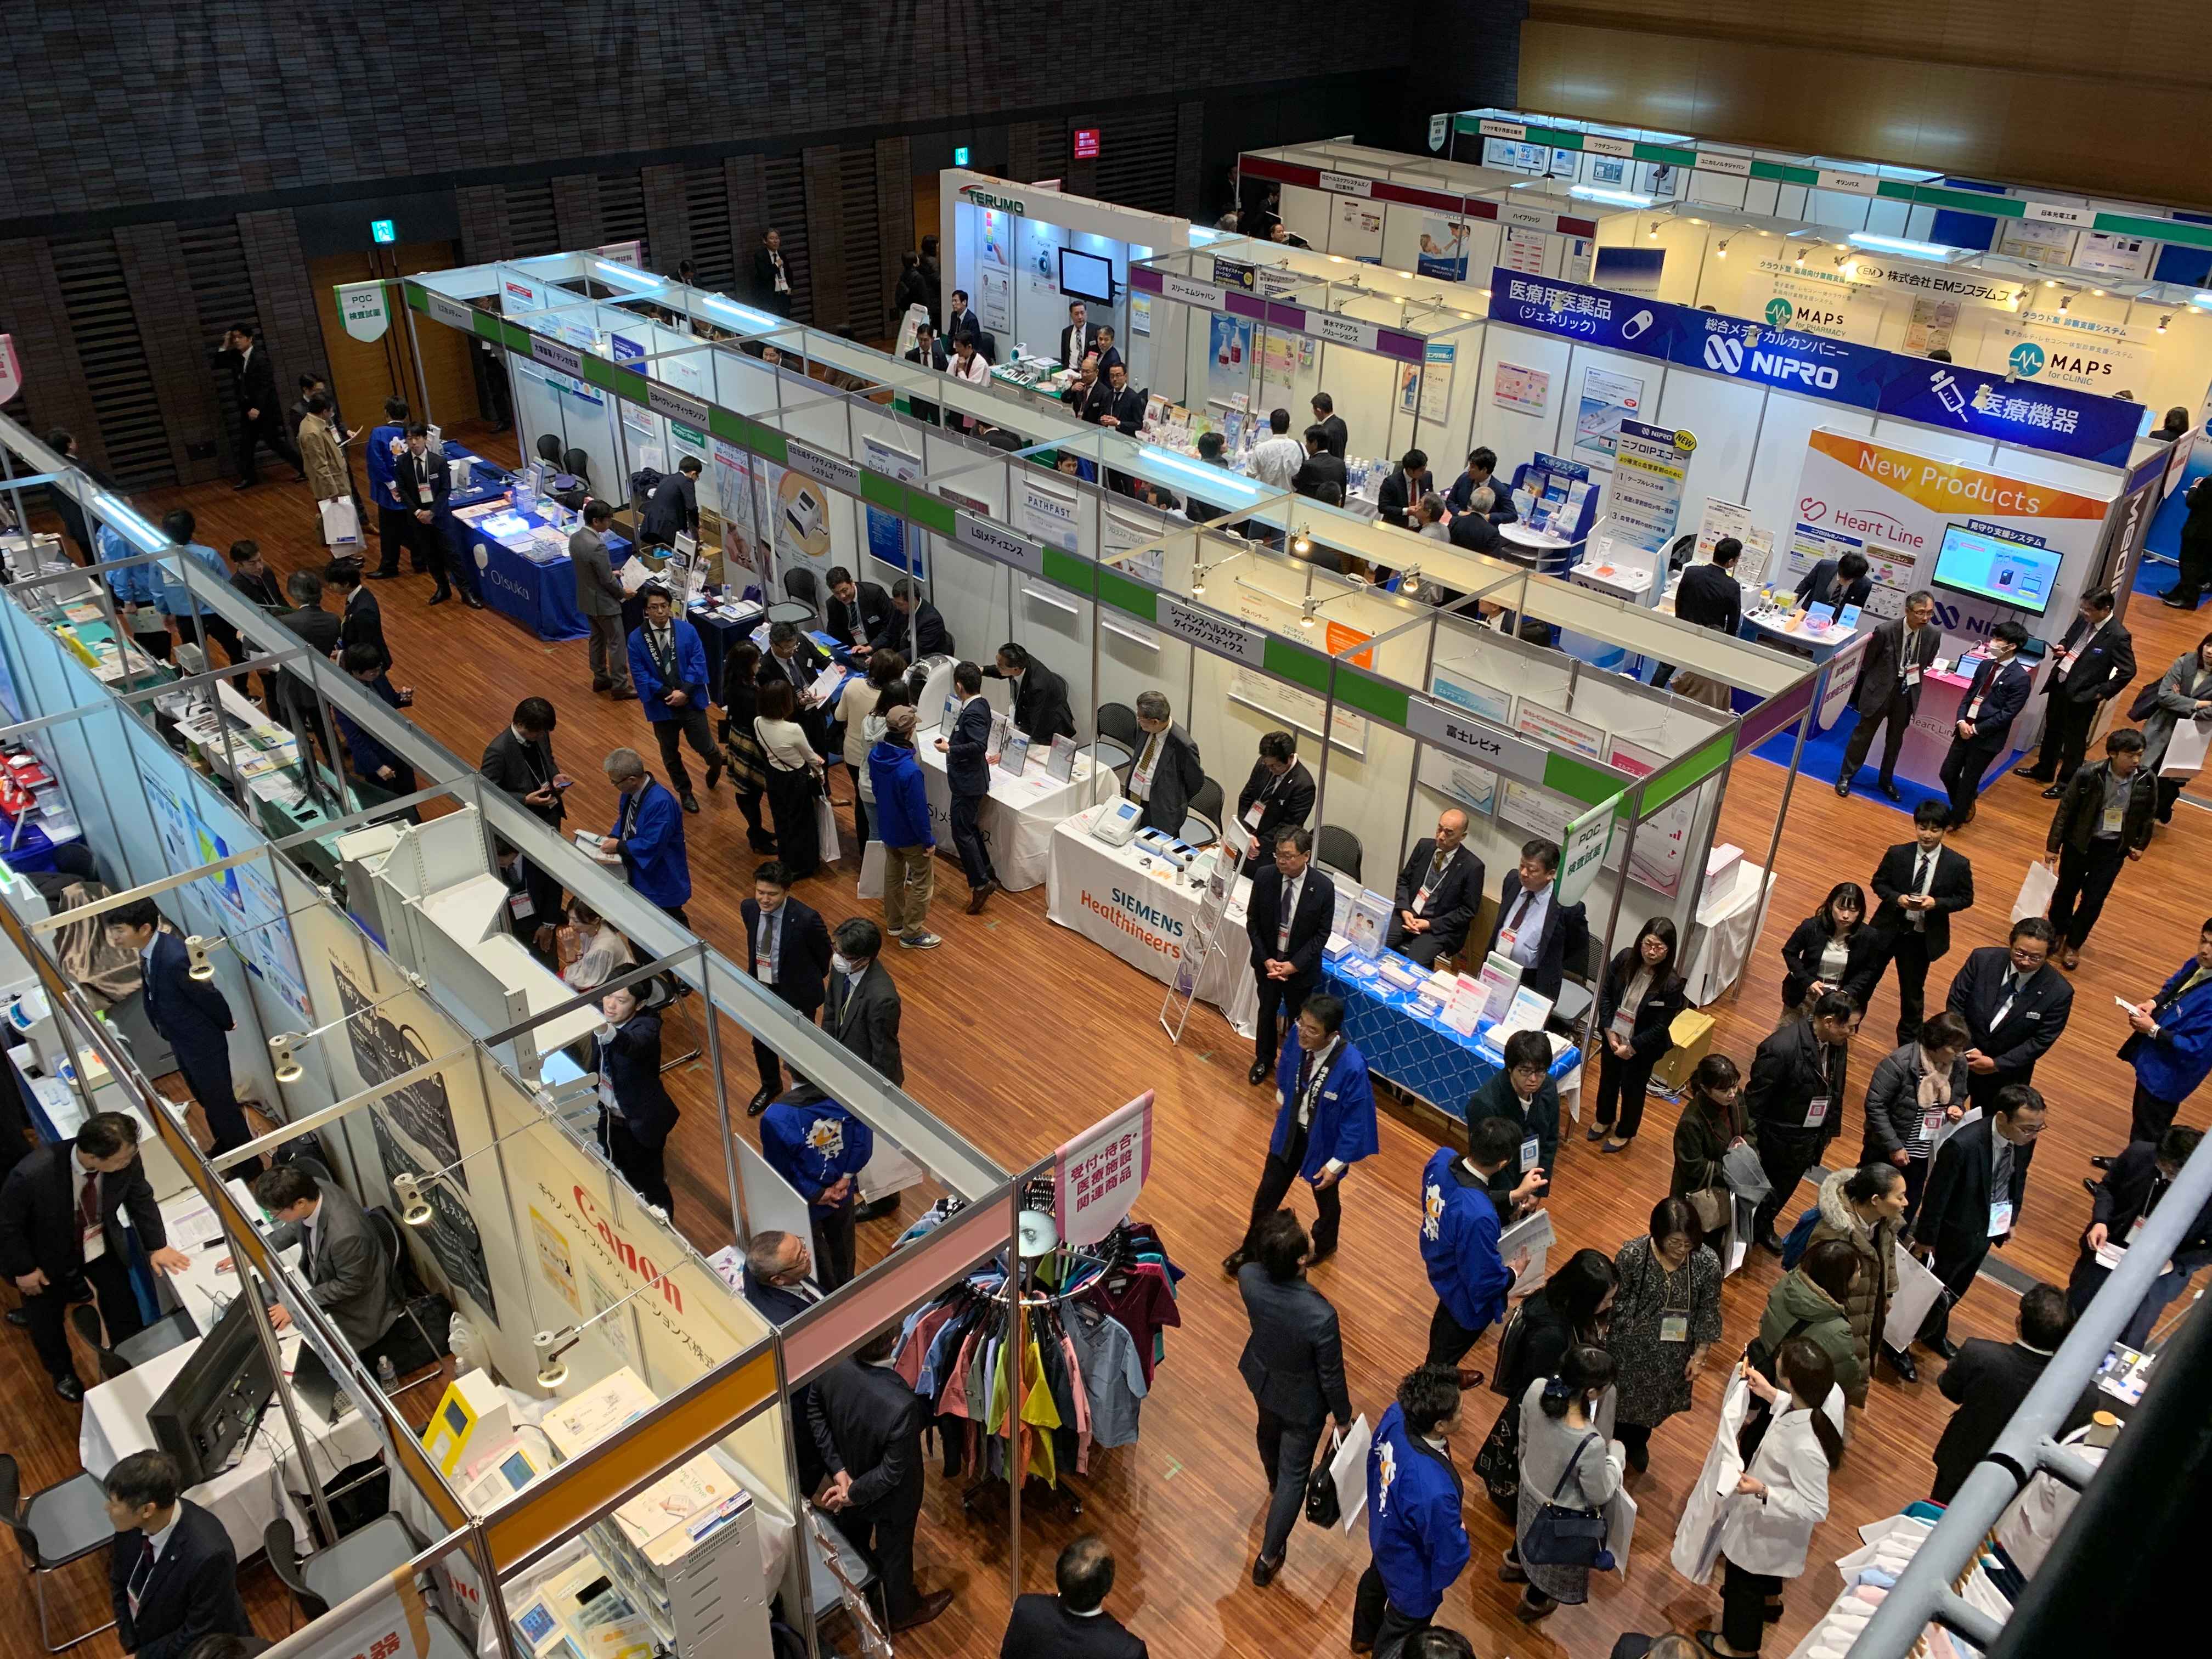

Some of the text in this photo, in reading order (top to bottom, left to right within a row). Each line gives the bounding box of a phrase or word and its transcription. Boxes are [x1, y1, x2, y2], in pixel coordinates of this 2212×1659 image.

[1594, 142, 1622, 151] フクダコーリン
[1700, 158, 1746, 170] コニカミノルタジャパン
[1835, 179, 1859, 188] オリンパス
[967, 189, 1024, 214] TERUMO
[1513, 213, 1541, 223] ハイブリッジ
[1759, 261, 1792, 273] クラウド型
[1862, 266, 1877, 276] EM
[1887, 269, 1933, 290] 株式会社
[351, 294, 373, 303] POC
[1171, 283, 1216, 301] スリーエムジャパン
[1508, 279, 1612, 321] 医療用医薬品
[349, 308, 381, 321] 検査試薬
[2022, 311, 2060, 325] クラウド型
[1322, 327, 1359, 343] ソリューションズ
[1323, 319, 1358, 334] 積水マテリアル
[1704, 317, 1849, 357] 総合メディカルカンパニー
[1795, 321, 1847, 337] for PHARMACY
[1751, 350, 1839, 390] NIPRO
[2047, 370, 2094, 386] for CLINIC
[1978, 393, 2080, 435] 医療機器
[1621, 438, 1683, 461] ニプロIPエコー
[1651, 430, 1694, 448] NIPRO NEW
[1858, 449, 2041, 514] New Products
[1028, 495, 1070, 518] PATHFAST
[1615, 492, 1621, 501] 2
[1611, 511, 1617, 521] 3
[1835, 510, 1923, 549] Heart Line
[1970, 522, 2043, 547] 見守り支援システム
[971, 526, 1024, 557] LSIメディエンス
[1173, 618, 1244, 654] ダイアグノスティクス
[1446, 723, 1502, 755] 富士レビオ
[1578, 823, 1601, 846] POC
[1567, 842, 1603, 877] 検査試薬
[1111, 887, 1183, 938] SIEMENS
[1080, 889, 1181, 960] Healthineers
[1076, 1149, 1132, 1197] 医療施設
[1076, 1164, 1132, 1213] 関連商品
[572, 1184, 684, 1316] Canon
